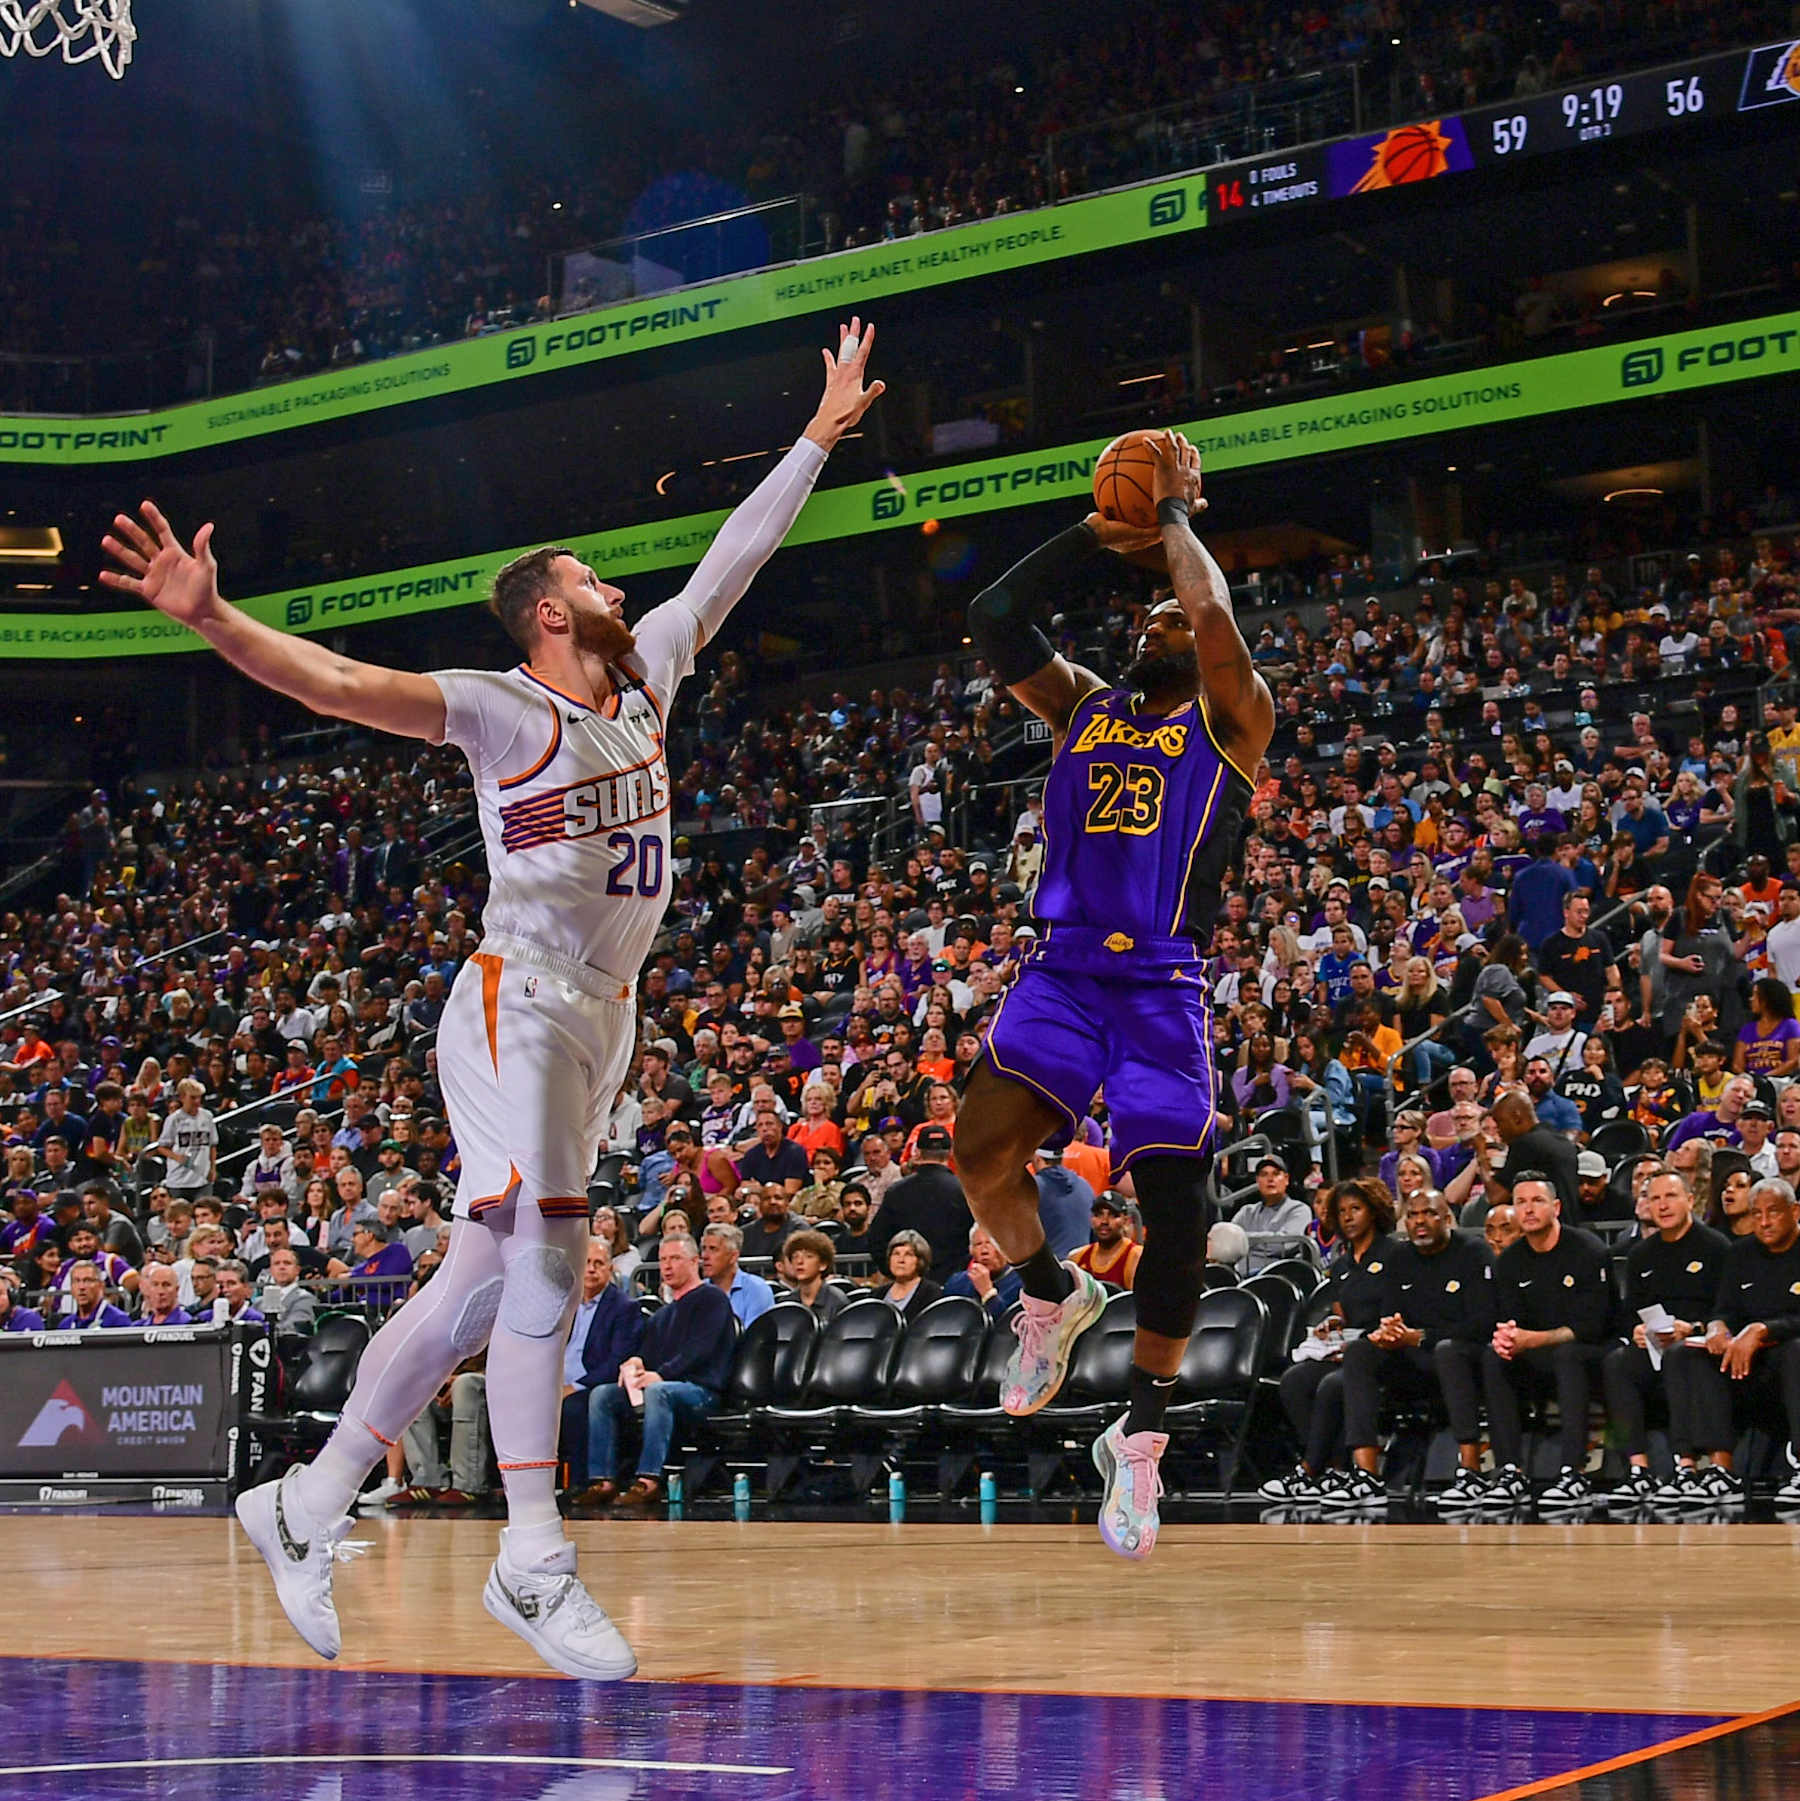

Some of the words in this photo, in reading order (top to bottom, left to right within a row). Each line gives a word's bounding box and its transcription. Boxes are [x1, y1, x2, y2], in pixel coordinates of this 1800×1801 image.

[1562, 84, 1623, 128] 9:19
[1666, 76, 1704, 116] 56
[1492, 115, 1527, 154] 59
[1261, 162, 1297, 183] FOULS
[1216, 180, 1245, 211] 14
[1262, 180, 1319, 206] TIMEOUTS
[775, 276, 845, 300] HEALTHY
[918, 241, 992, 268] HEALTHY
[545, 298, 724, 355] FOOTPRINT
[207, 400, 291, 429] SUSTAINABLE
[295, 382, 371, 407] PACKAGING
[374, 363, 450, 391] SOLUTIONS
[1195, 424, 1292, 455] STAINABLE
[1297, 403, 1407, 436] PACKAGING
[1412, 382, 1522, 415] SOLUTIONS
[915, 456, 1098, 507] FOOTPRIN
[320, 569, 479, 615] FOOTPRINT
[40, 627, 137, 642] PACKAGING
[1029, 723, 1049, 740] 101
[1070, 713, 1188, 758] LAKERS
[1084, 762, 1165, 836] 23
[605, 832, 664, 897] 20
[45, 1334, 83, 1346] FANDUEL
[156, 1331, 197, 1342] FANDUEL
[102, 1384, 203, 1408] MOUNTAIN
[107, 1409, 197, 1432] AMERICA
[249, 1371, 265, 1468] FANEL
[117, 1436, 153, 1445] CREDIT
